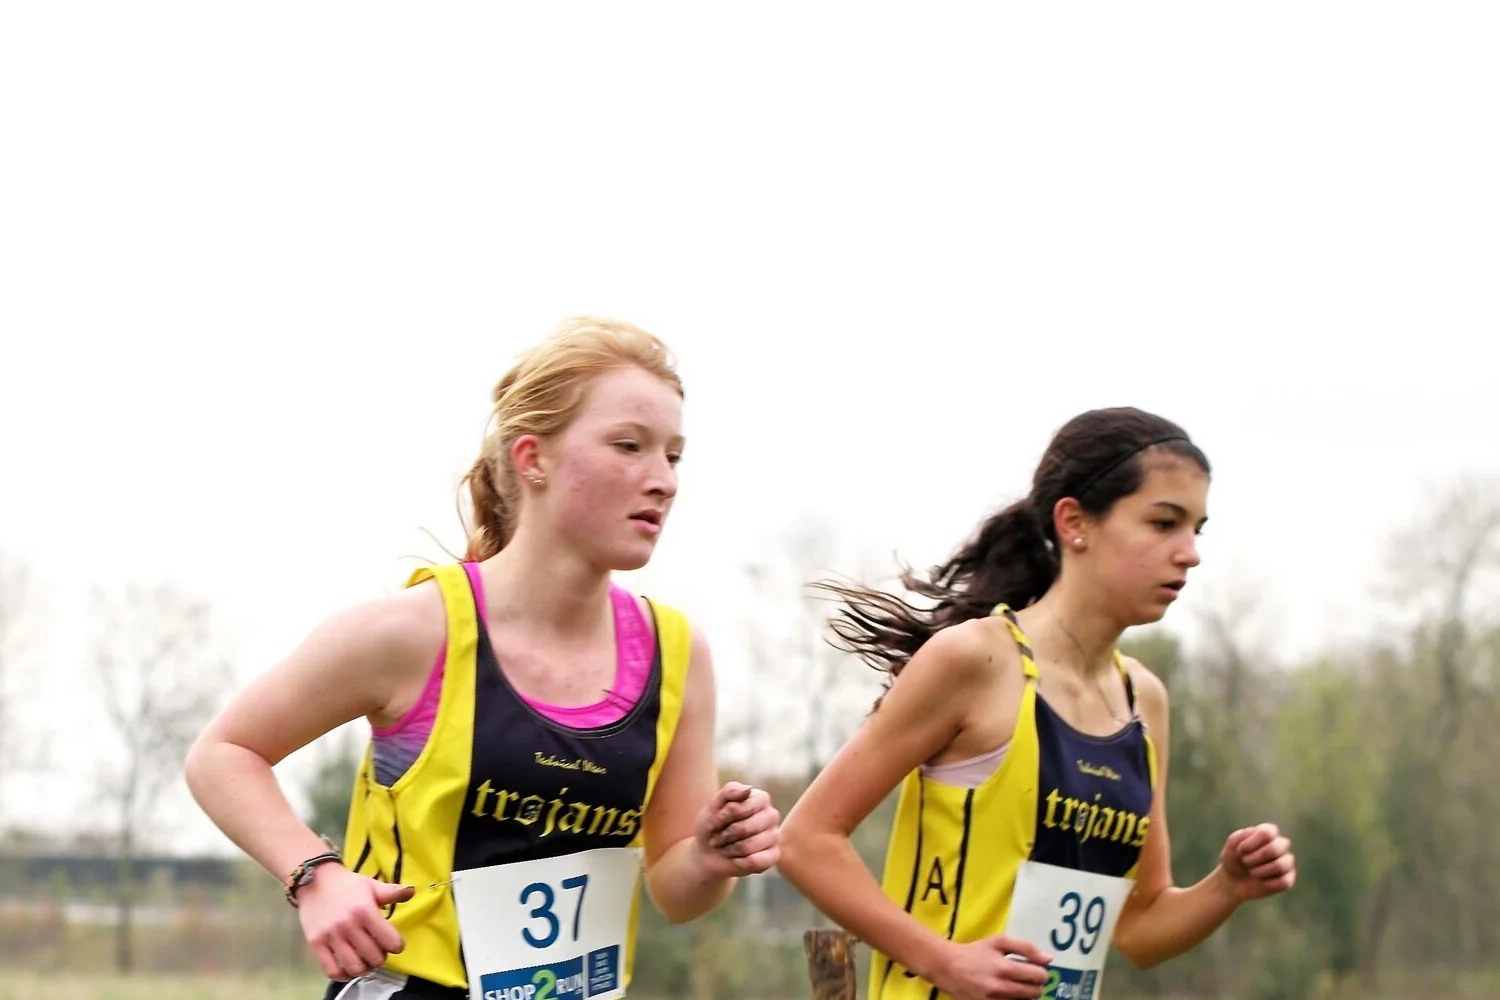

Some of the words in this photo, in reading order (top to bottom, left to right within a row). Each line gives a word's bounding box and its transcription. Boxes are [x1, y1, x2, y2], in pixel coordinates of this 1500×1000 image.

[471, 778, 643, 838] trojans
[1043, 787, 1150, 847] trojans
[519, 874, 589, 949] 37
[1051, 892, 1105, 955] 39
